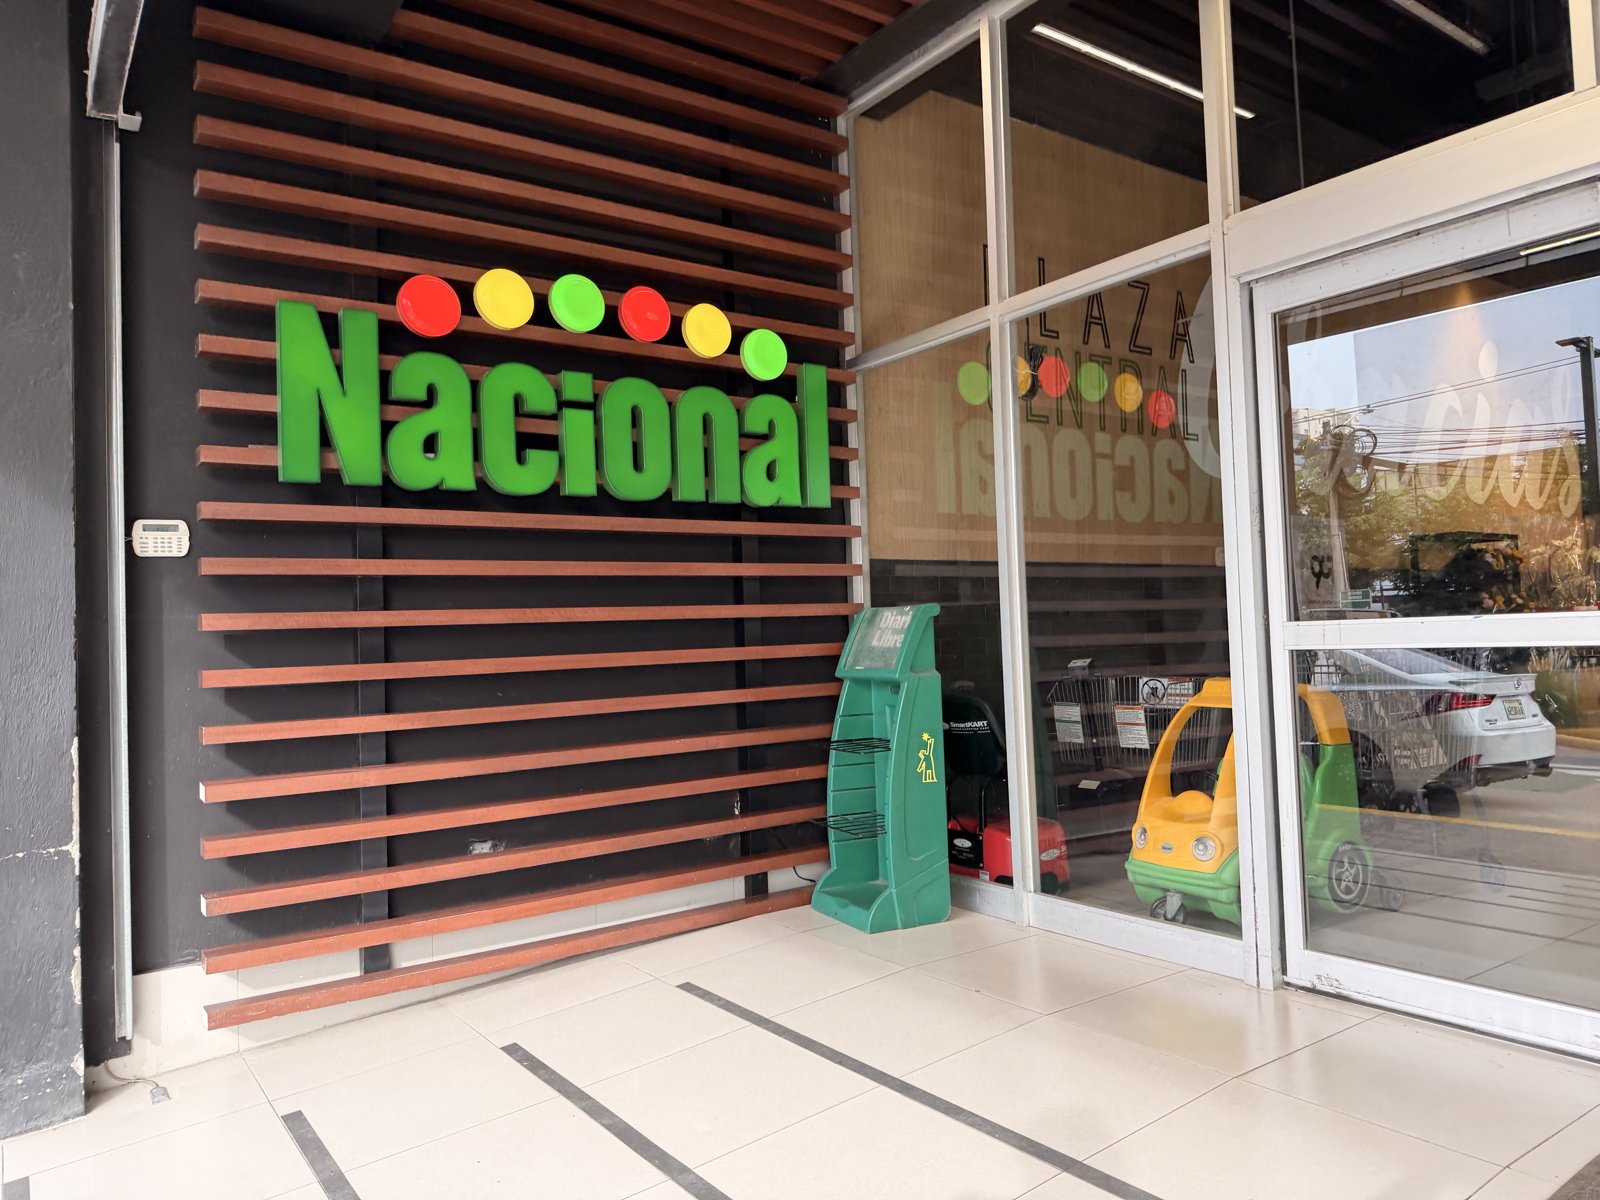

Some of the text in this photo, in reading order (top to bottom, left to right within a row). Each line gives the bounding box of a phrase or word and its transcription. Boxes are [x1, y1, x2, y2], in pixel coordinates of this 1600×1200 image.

[276, 300, 831, 508] Nacional
[871, 628, 905, 648] Libre
[949, 720, 988, 728] SmartKART
